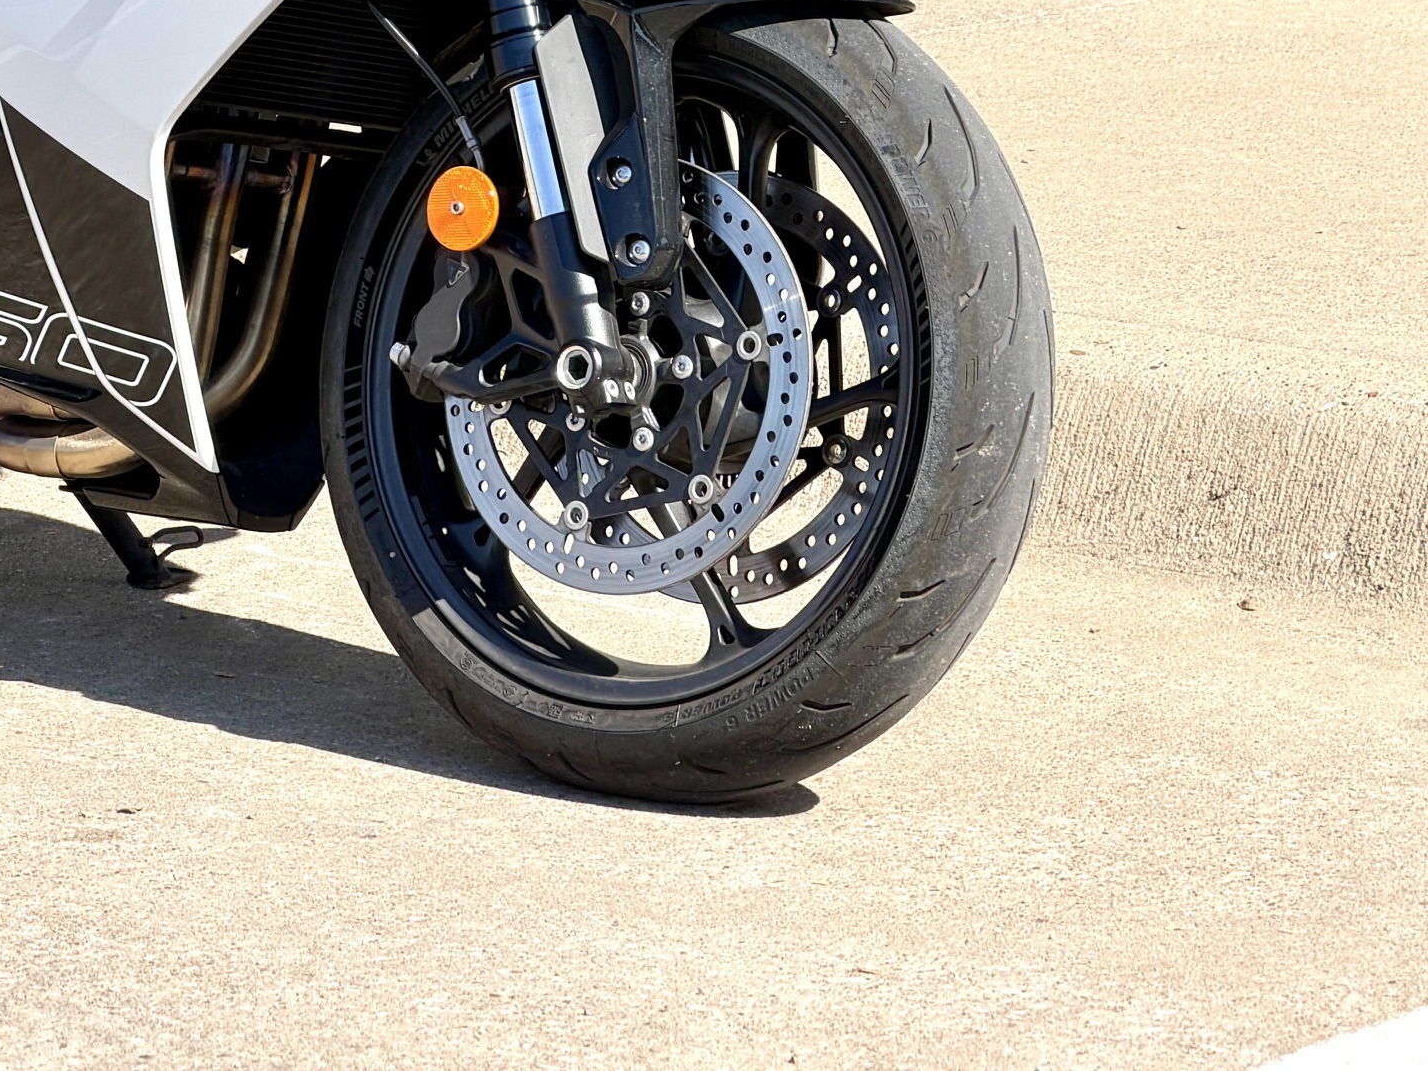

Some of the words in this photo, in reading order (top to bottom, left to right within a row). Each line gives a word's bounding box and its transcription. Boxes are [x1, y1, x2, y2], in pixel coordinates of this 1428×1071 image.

[353, 281, 370, 328] FRONT
[745, 665, 815, 723] POWER
[726, 715, 739, 731] 6
